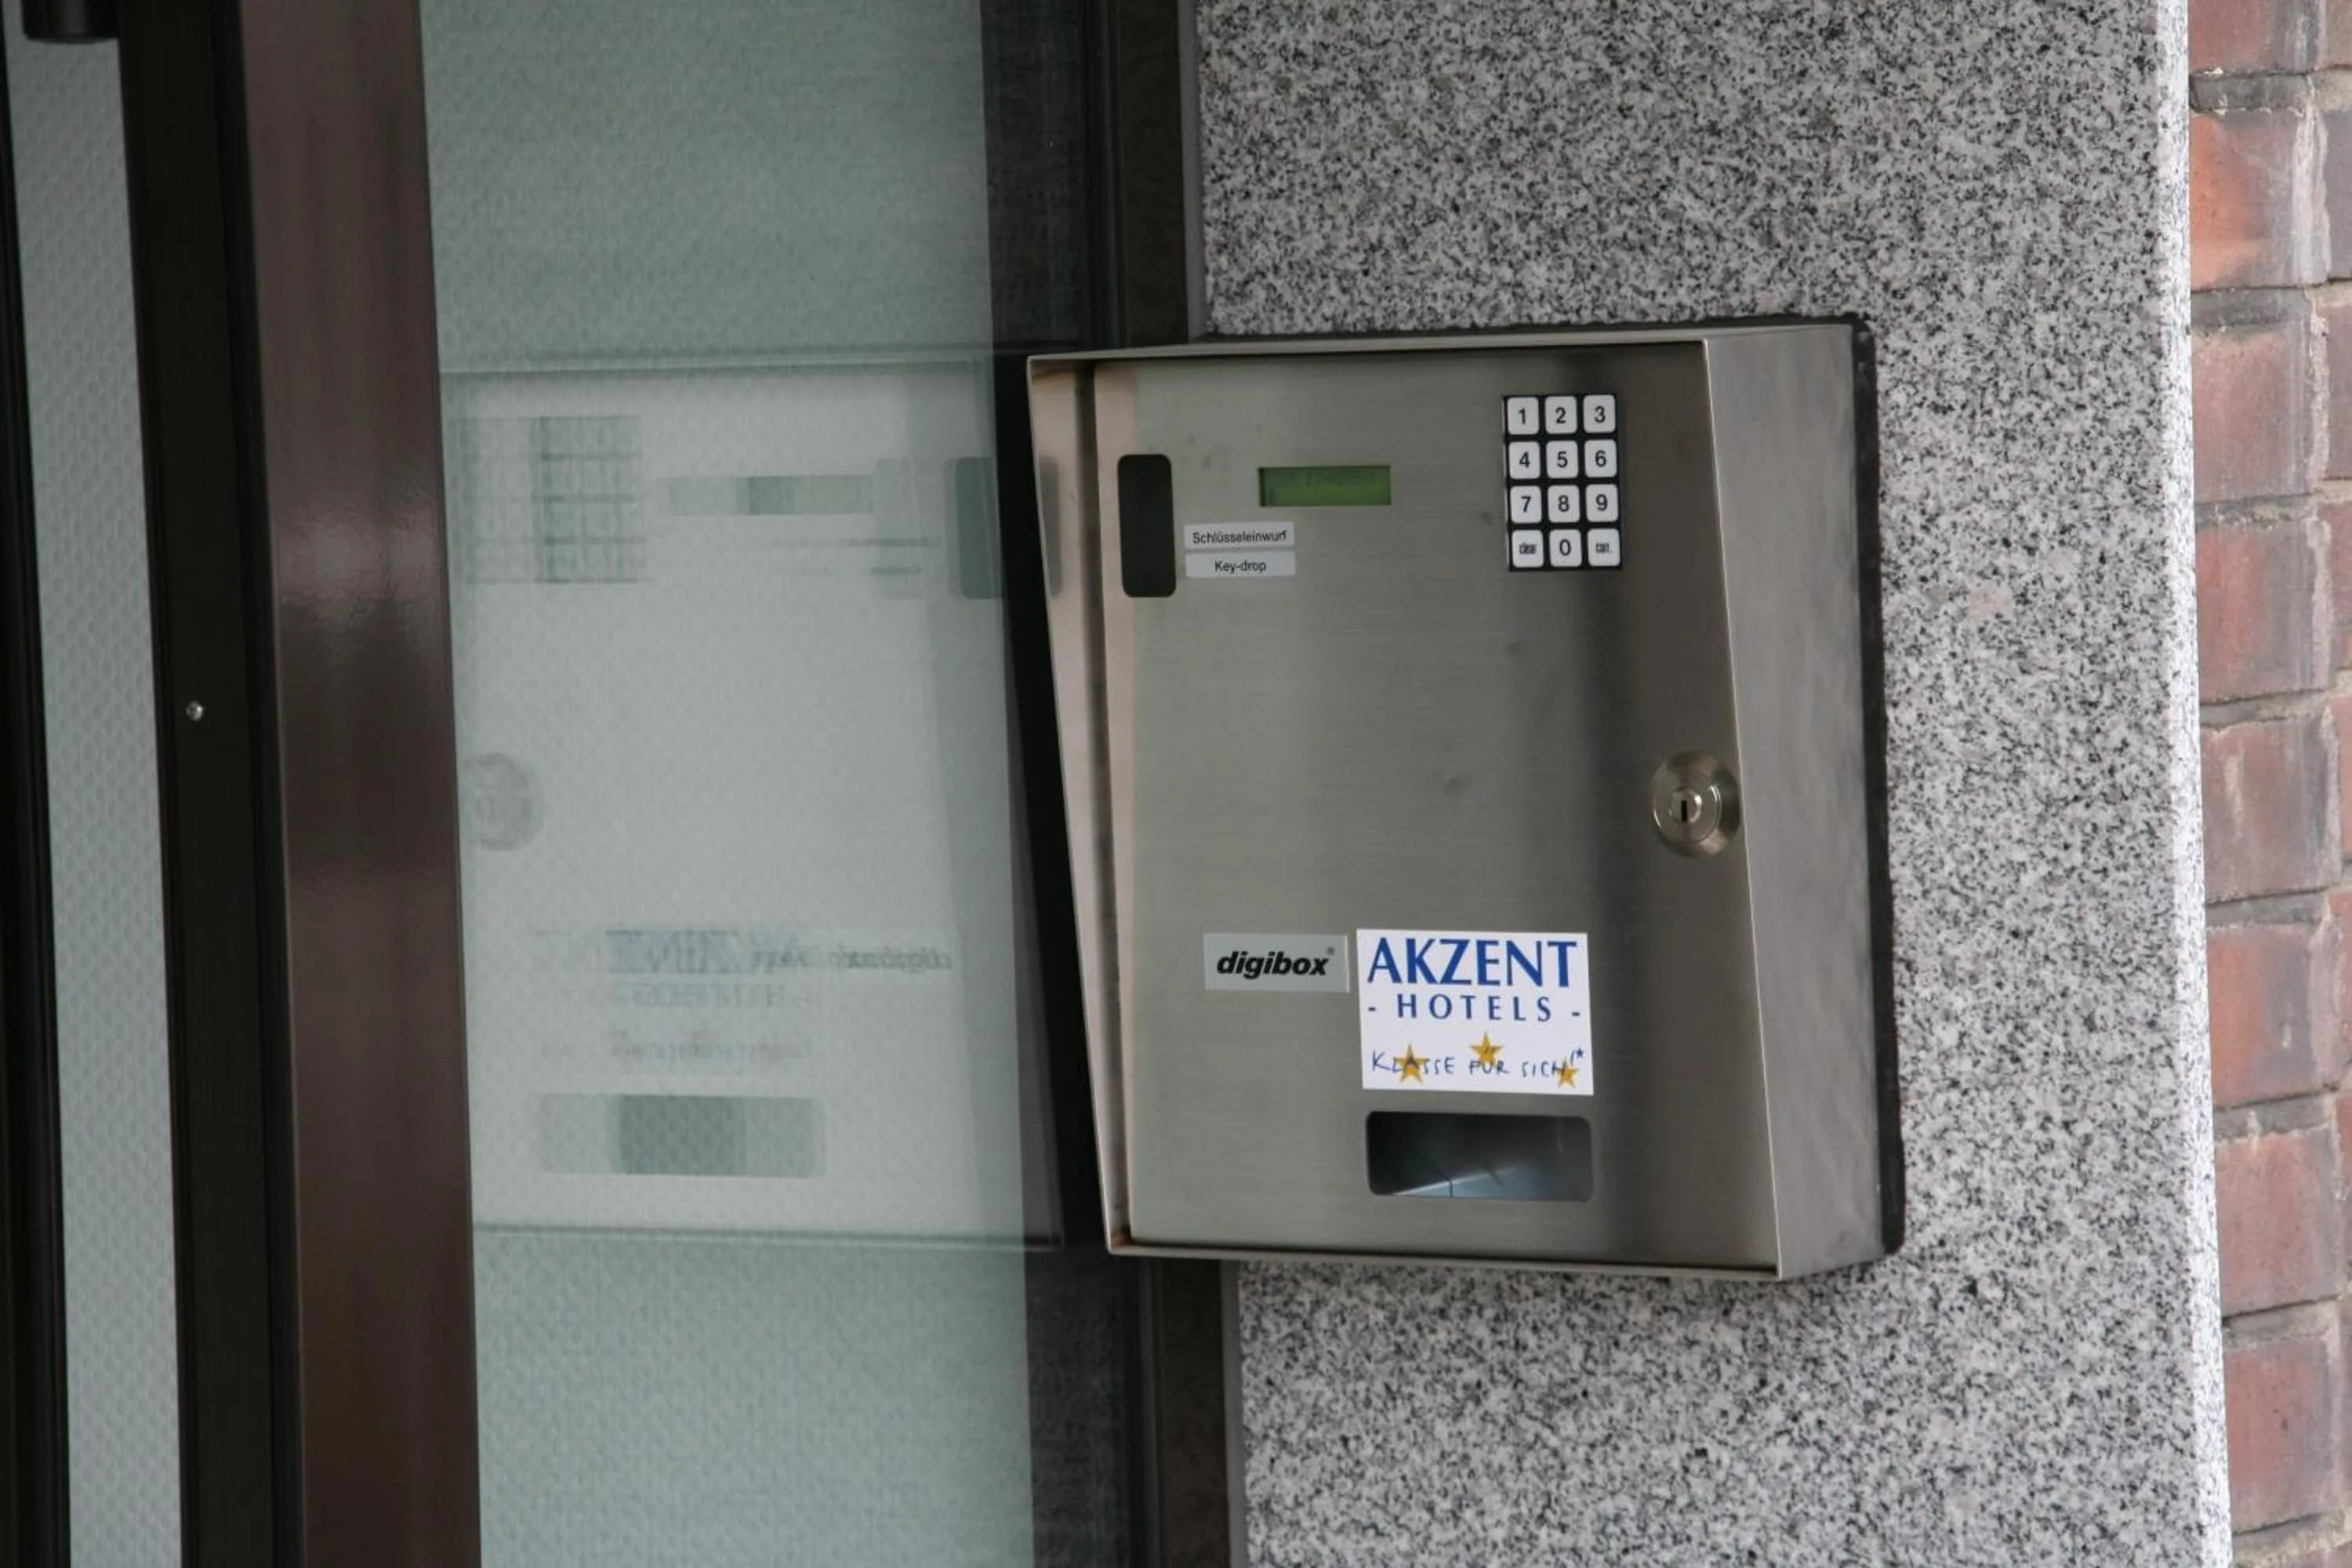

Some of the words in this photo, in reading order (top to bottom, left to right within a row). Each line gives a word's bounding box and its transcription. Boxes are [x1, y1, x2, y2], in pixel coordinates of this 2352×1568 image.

[1518, 408, 1526, 425] 1
[1555, 406, 1566, 424] 2
[1594, 405, 1606, 424] 3
[1519, 451, 1531, 469] 4
[1556, 451, 1569, 469] 5
[1594, 449, 1607, 468] 6
[1521, 495, 1532, 513] 7
[1557, 494, 1570, 513] 8
[1595, 493, 1608, 512] 9
[1192, 529, 1287, 544] Schlüsseleinwurf
[1559, 539, 1572, 557] 0
[1214, 560, 1267, 575] Key-drop
[1367, 936, 1577, 988] AKZENT
[1396, 993, 1552, 1022] HOTELS
